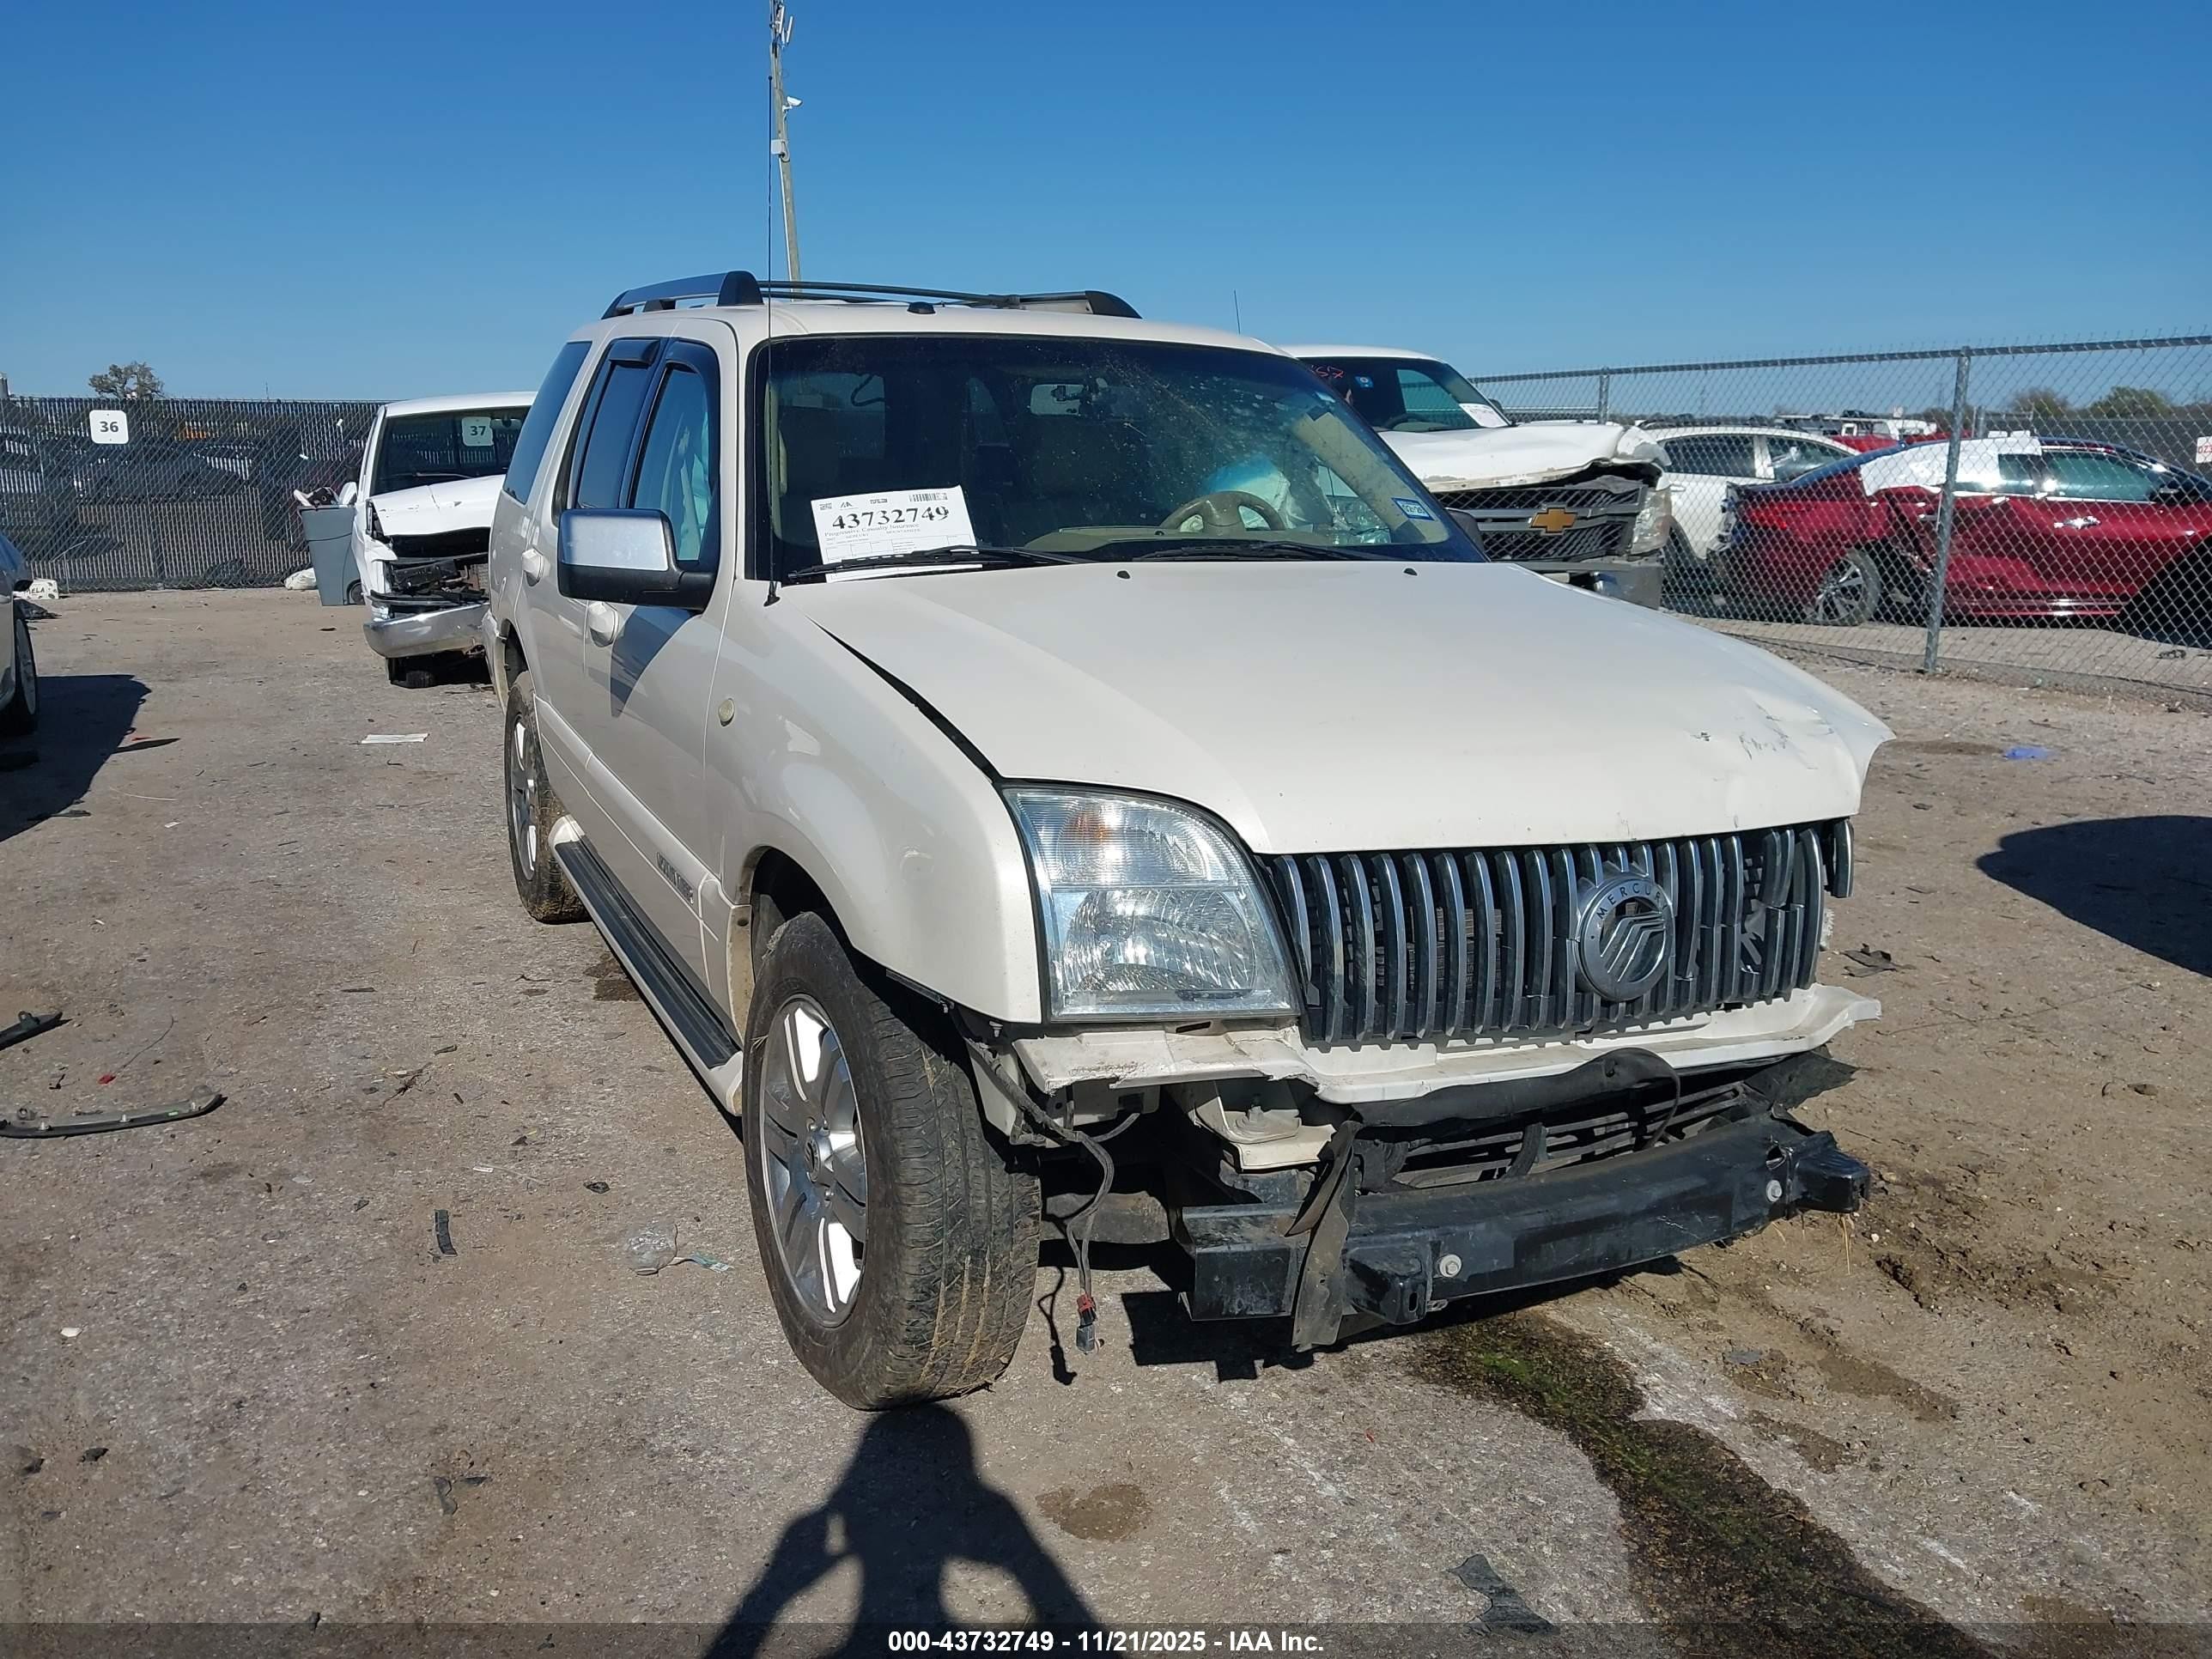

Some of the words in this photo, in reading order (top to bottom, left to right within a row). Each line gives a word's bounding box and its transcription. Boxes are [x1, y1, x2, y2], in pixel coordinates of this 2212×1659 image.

[100, 421, 119, 433] 36
[470, 425, 487, 436] 37
[832, 506, 949, 529] 43732749
